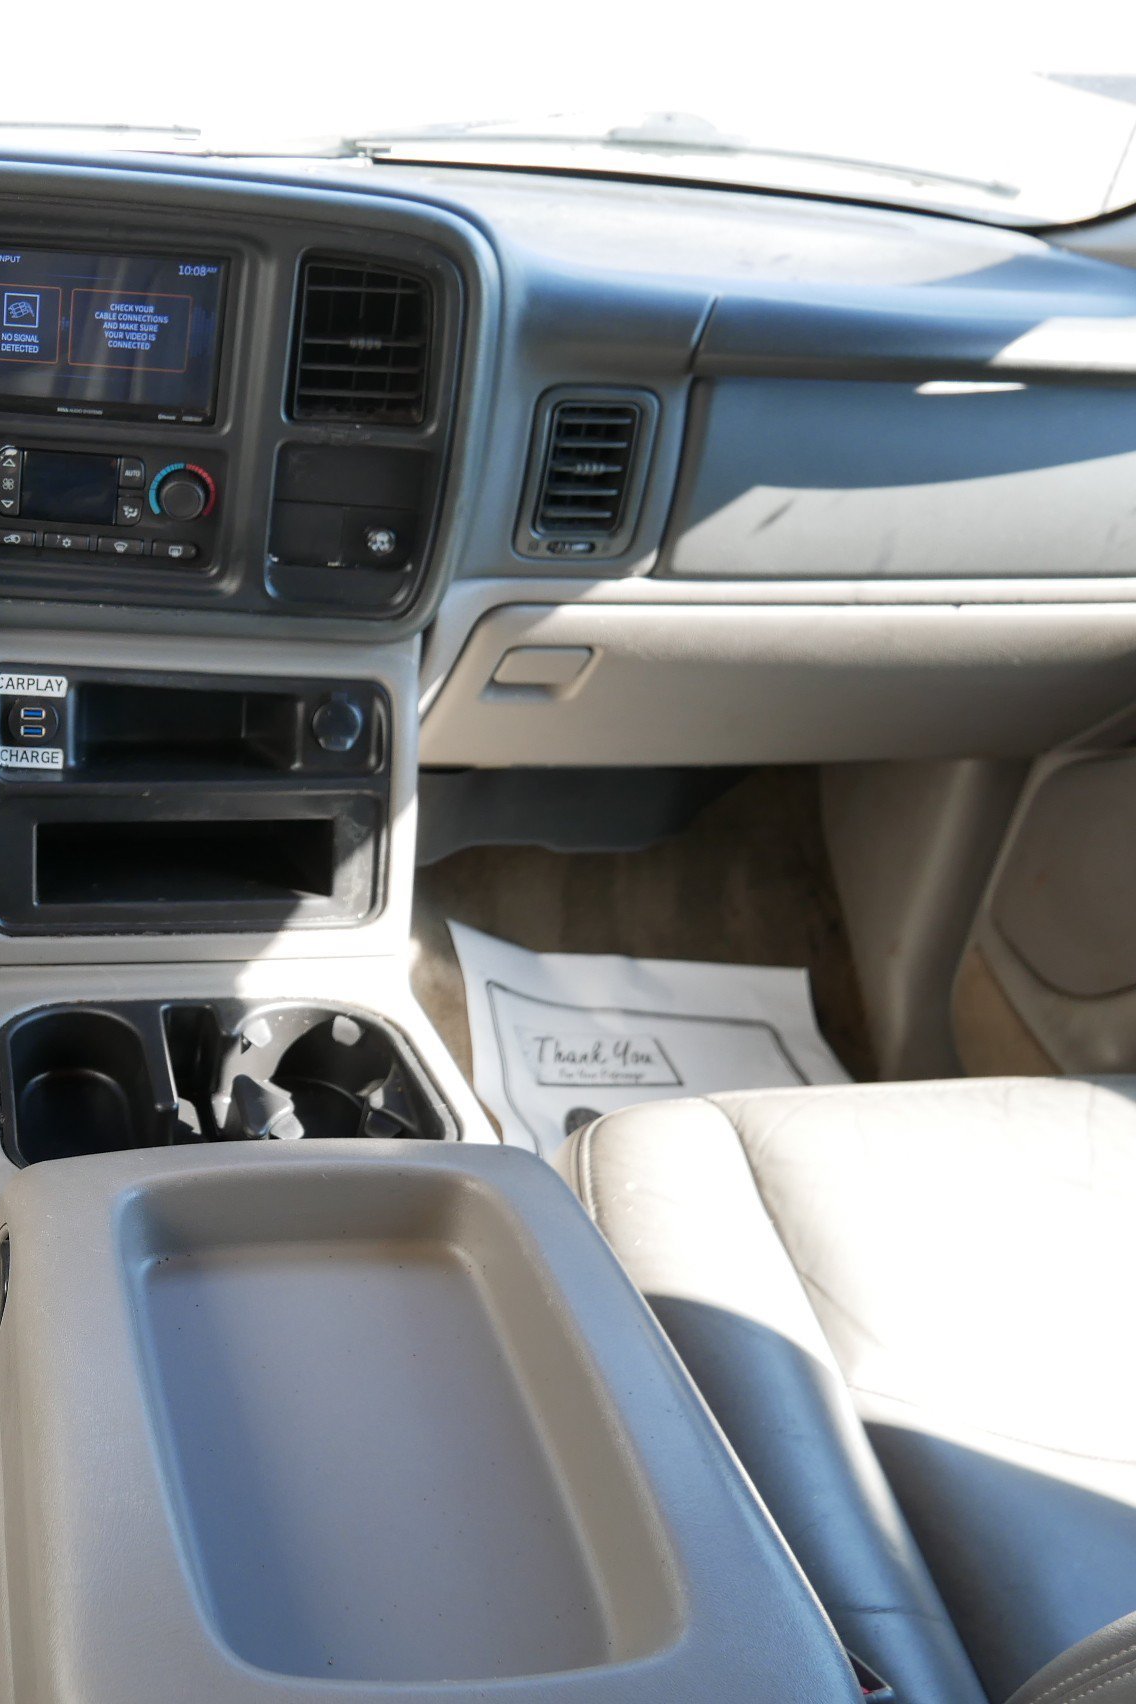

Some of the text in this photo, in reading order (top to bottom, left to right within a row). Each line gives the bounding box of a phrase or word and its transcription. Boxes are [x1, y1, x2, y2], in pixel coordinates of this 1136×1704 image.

[178, 265, 207, 277] 10:08
[109, 303, 155, 314] CHECK YOUR
[94, 311, 170, 324] CABLE CONNECTIONS
[103, 321, 160, 333] AND MAKE SURE
[1, 332, 39, 344] NO SIGNAL
[104, 330, 157, 341] YOUR VIDEO IS
[1, 343, 39, 354] DETECTED
[107, 340, 151, 351] CONNECTED
[124, 469, 141, 477] AUTO
[0, 749, 59, 764] CHARGE
